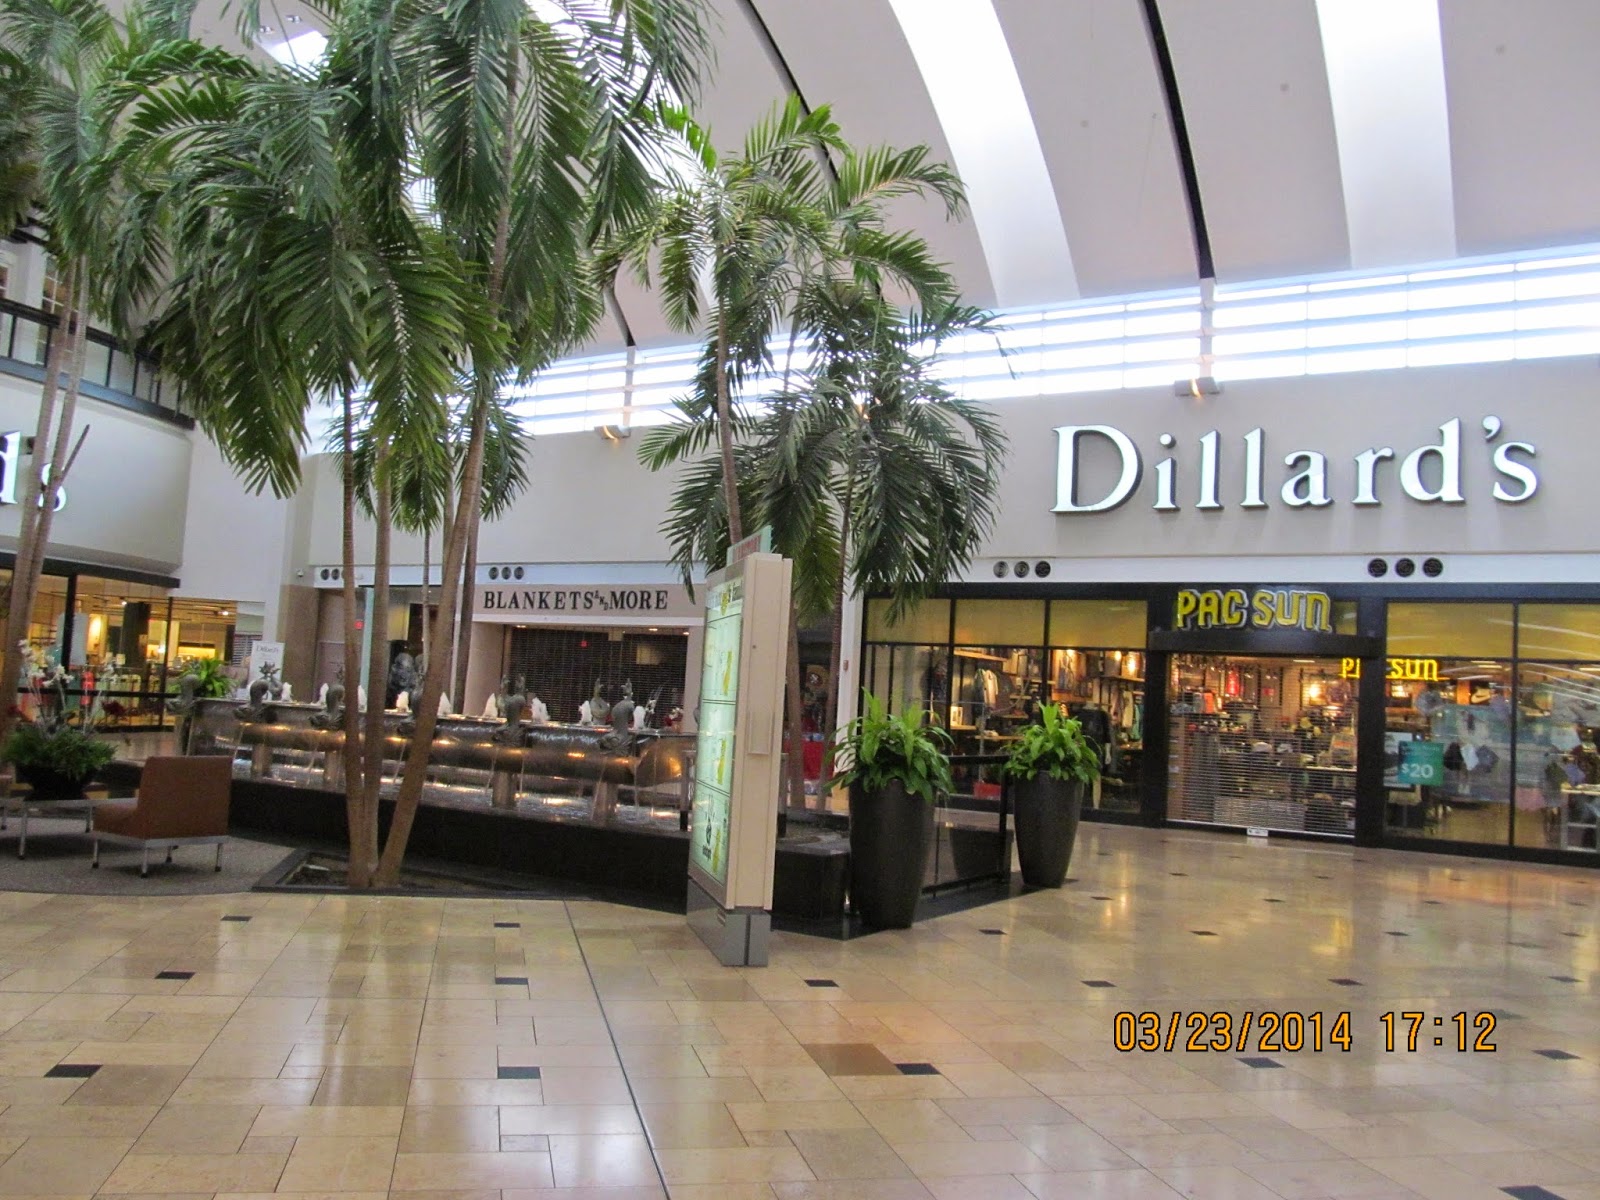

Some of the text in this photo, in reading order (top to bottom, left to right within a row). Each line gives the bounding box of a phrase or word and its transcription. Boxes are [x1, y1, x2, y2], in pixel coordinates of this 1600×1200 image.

[1049, 415, 1538, 514] Dillard's
[483, 590, 593, 610] BLANKETS
[608, 590, 669, 610] MORE
[1177, 589, 1249, 631] PAC
[1401, 762, 1434, 778] $20
